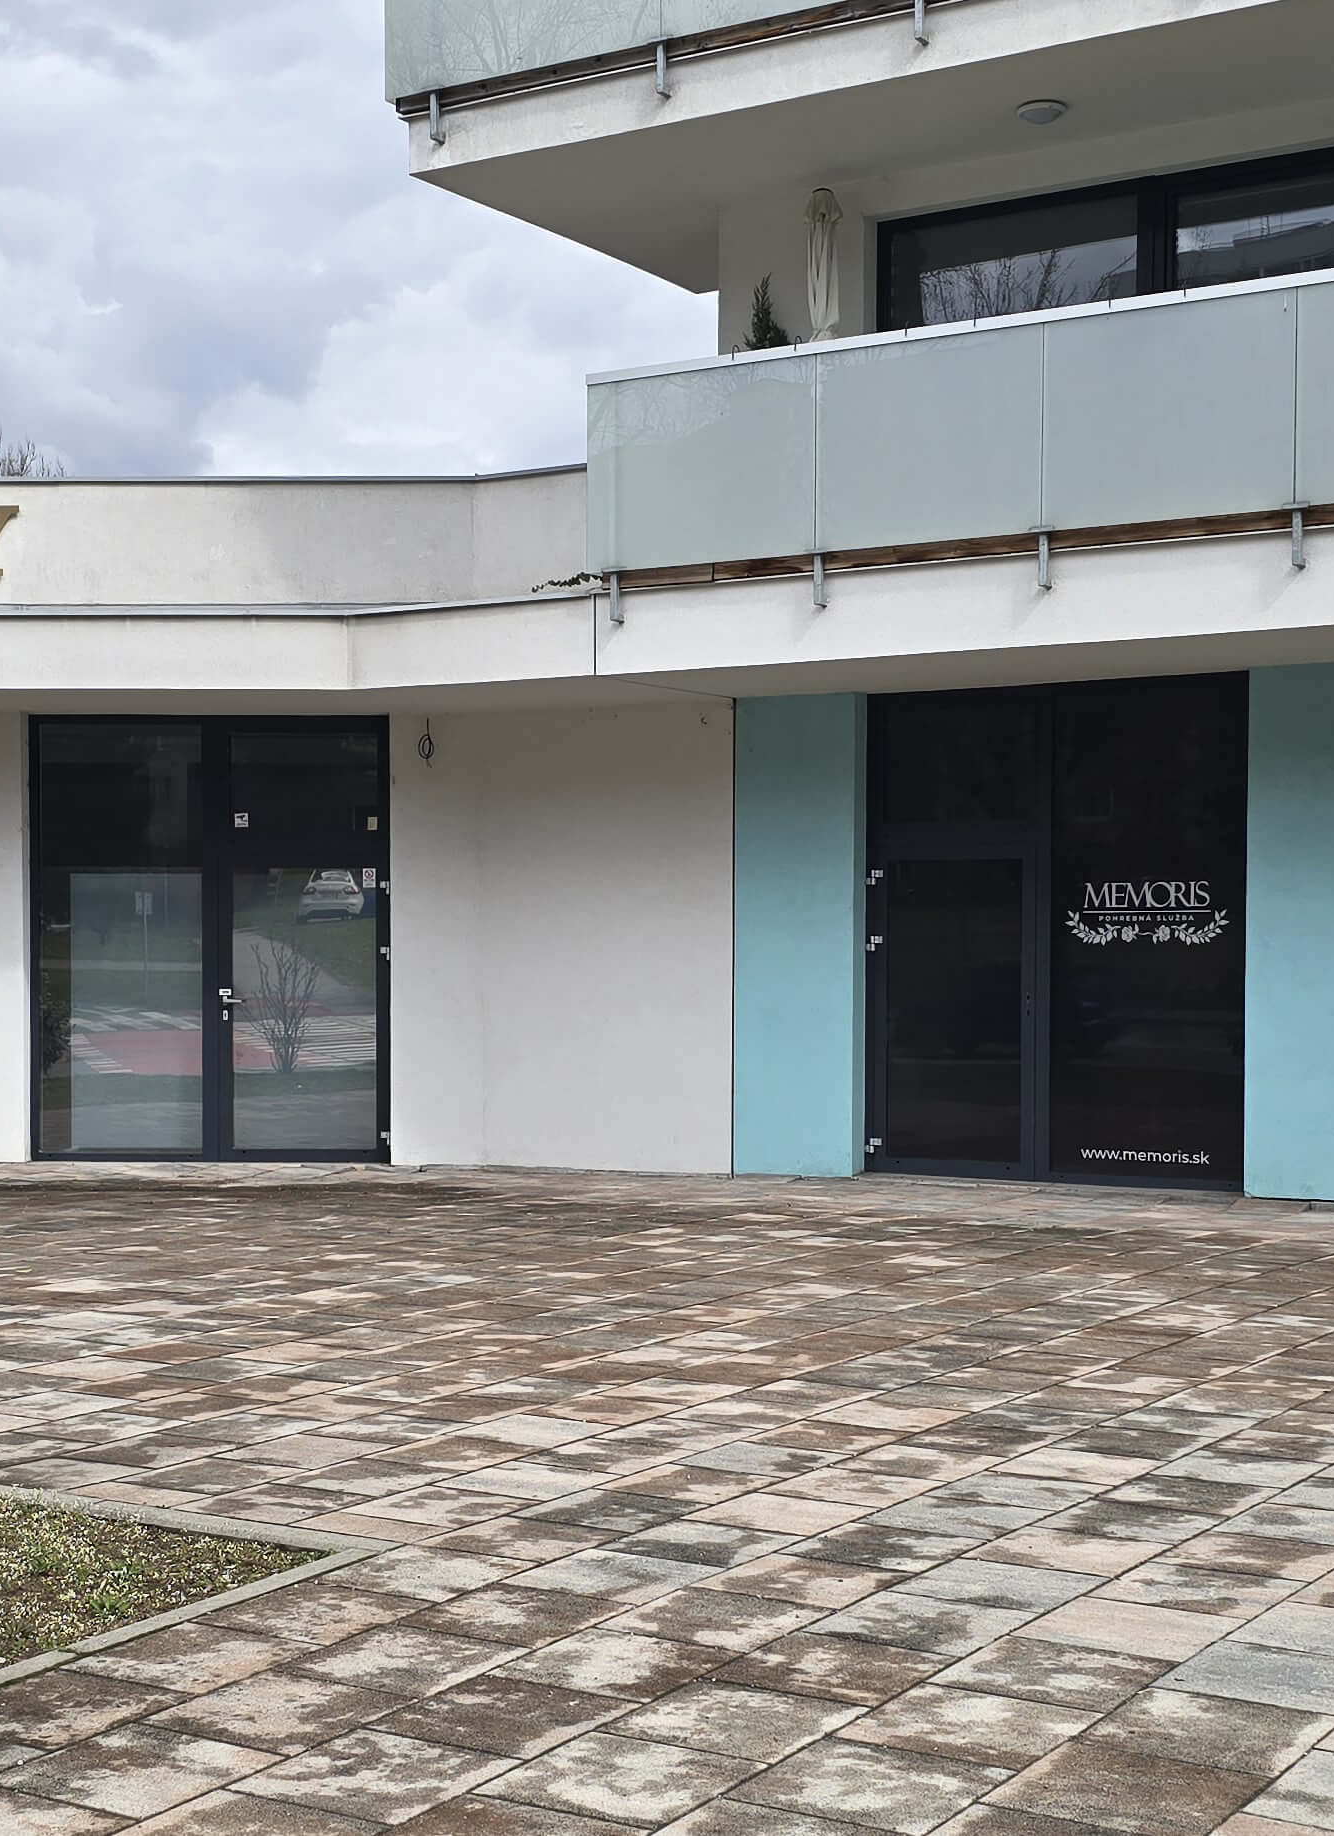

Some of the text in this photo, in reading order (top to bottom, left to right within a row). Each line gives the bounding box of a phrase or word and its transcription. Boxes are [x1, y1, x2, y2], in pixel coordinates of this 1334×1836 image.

[1083, 880, 1211, 908] MEMORIS
[1098, 913, 1195, 922] POHREBNÁ SLUŽBA
[1080, 1147, 1210, 1165] www.memoris.sk
